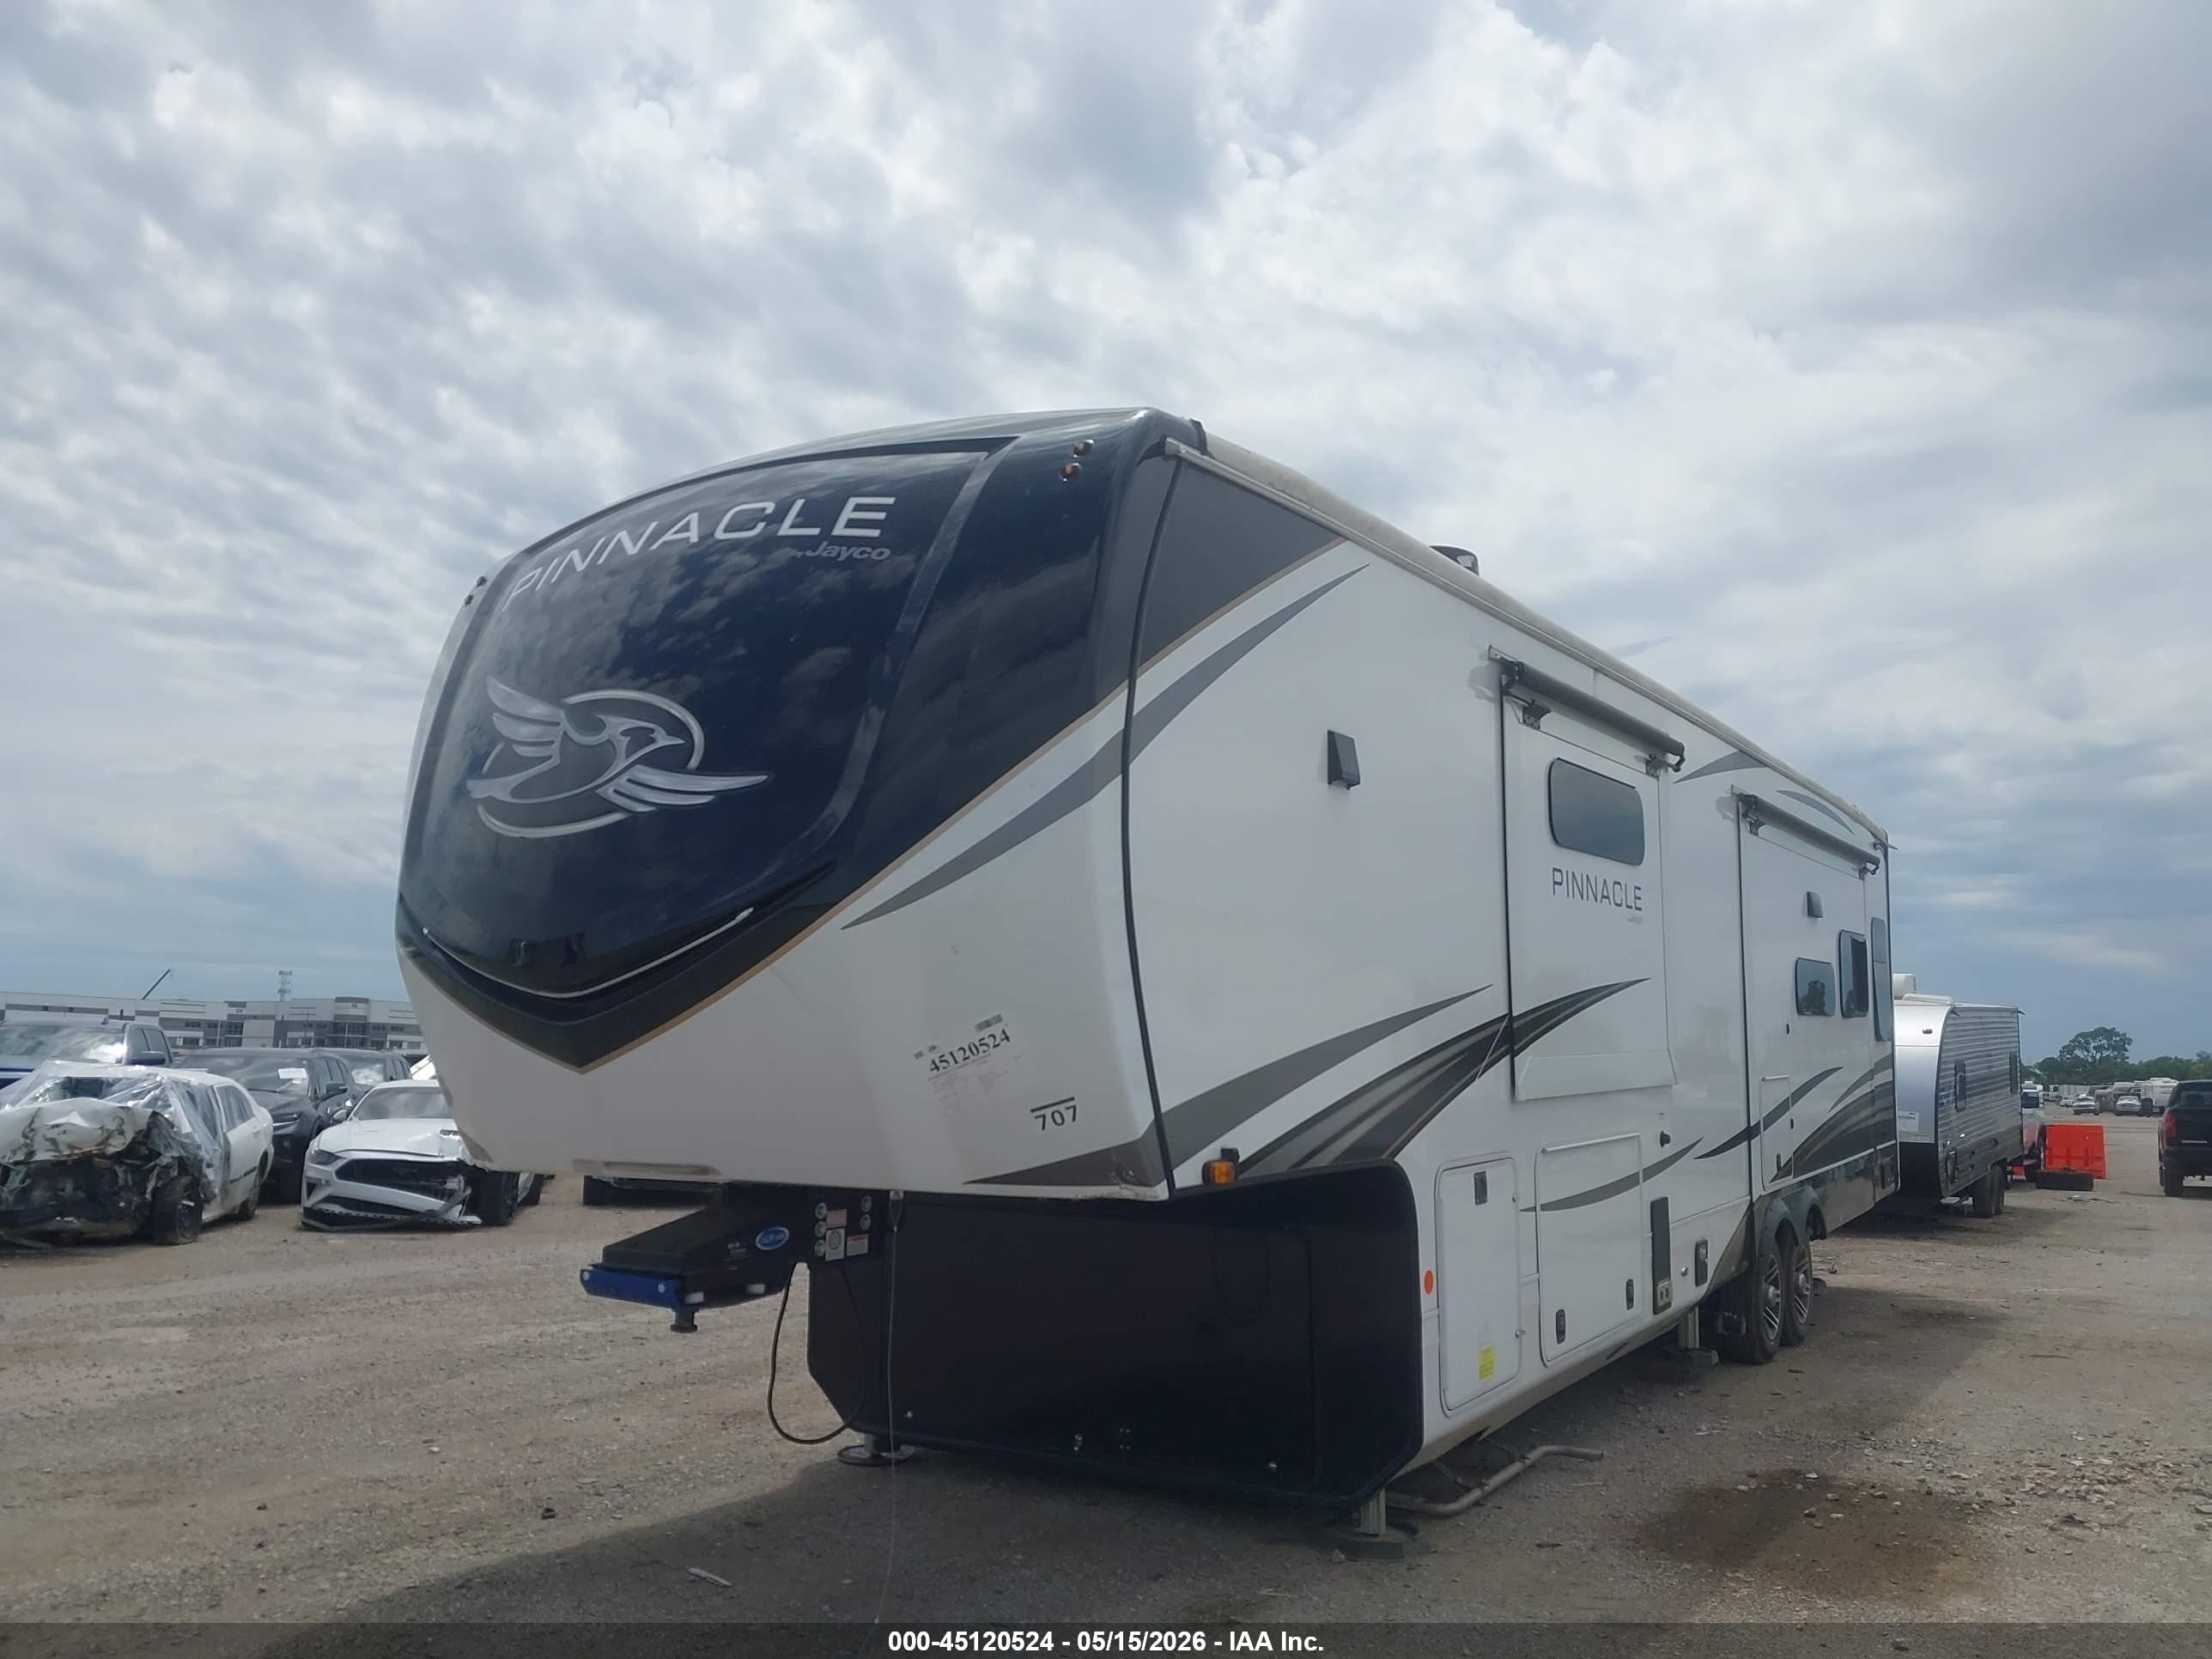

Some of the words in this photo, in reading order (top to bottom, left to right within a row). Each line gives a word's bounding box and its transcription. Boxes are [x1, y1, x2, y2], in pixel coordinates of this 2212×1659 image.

[501, 495, 896, 612] PINNACLE
[805, 541, 891, 562] Jayco
[1552, 866, 1643, 911] PINNACLE
[930, 1029, 1011, 1072] 45120524
[1033, 1104, 1078, 1131] 707
